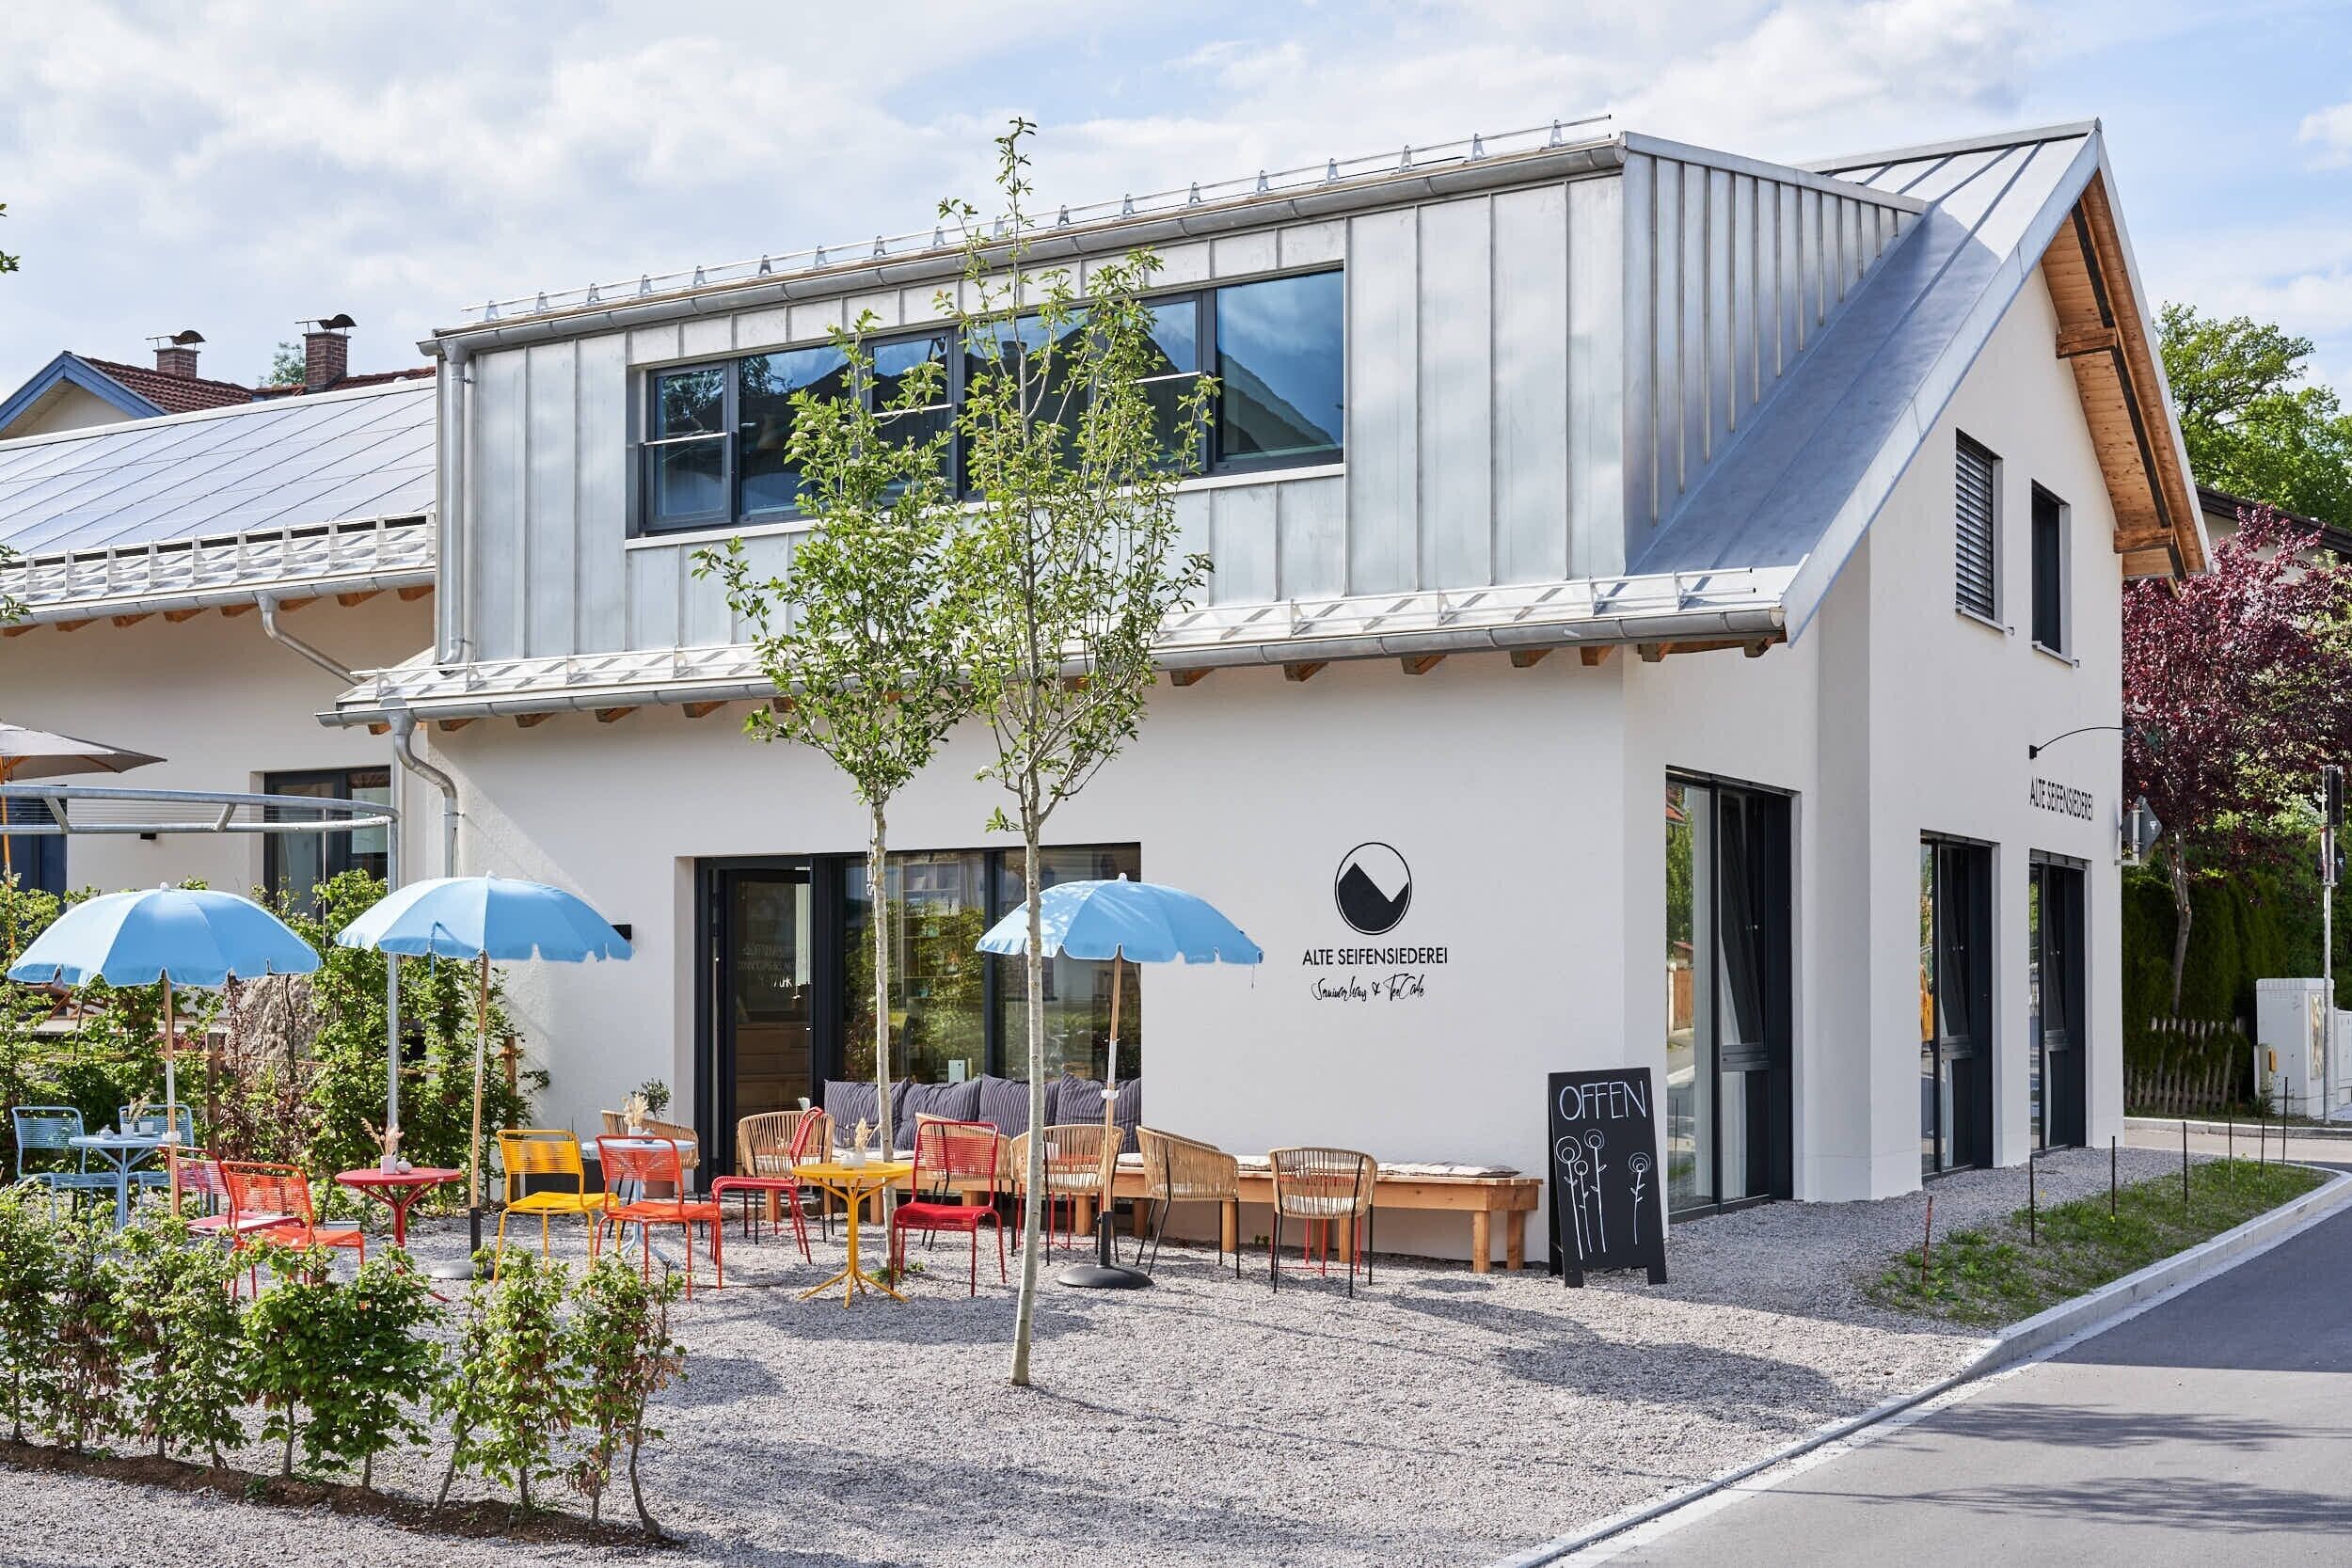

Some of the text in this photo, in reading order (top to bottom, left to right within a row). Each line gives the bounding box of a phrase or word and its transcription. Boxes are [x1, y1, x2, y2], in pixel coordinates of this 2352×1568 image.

[2029, 775, 2093, 821] ALTE SEIFENSIEDEREI
[1302, 947, 1448, 965] ALTE SEIFENSIEDEREI
[1559, 1080, 1646, 1120] OFFEN
